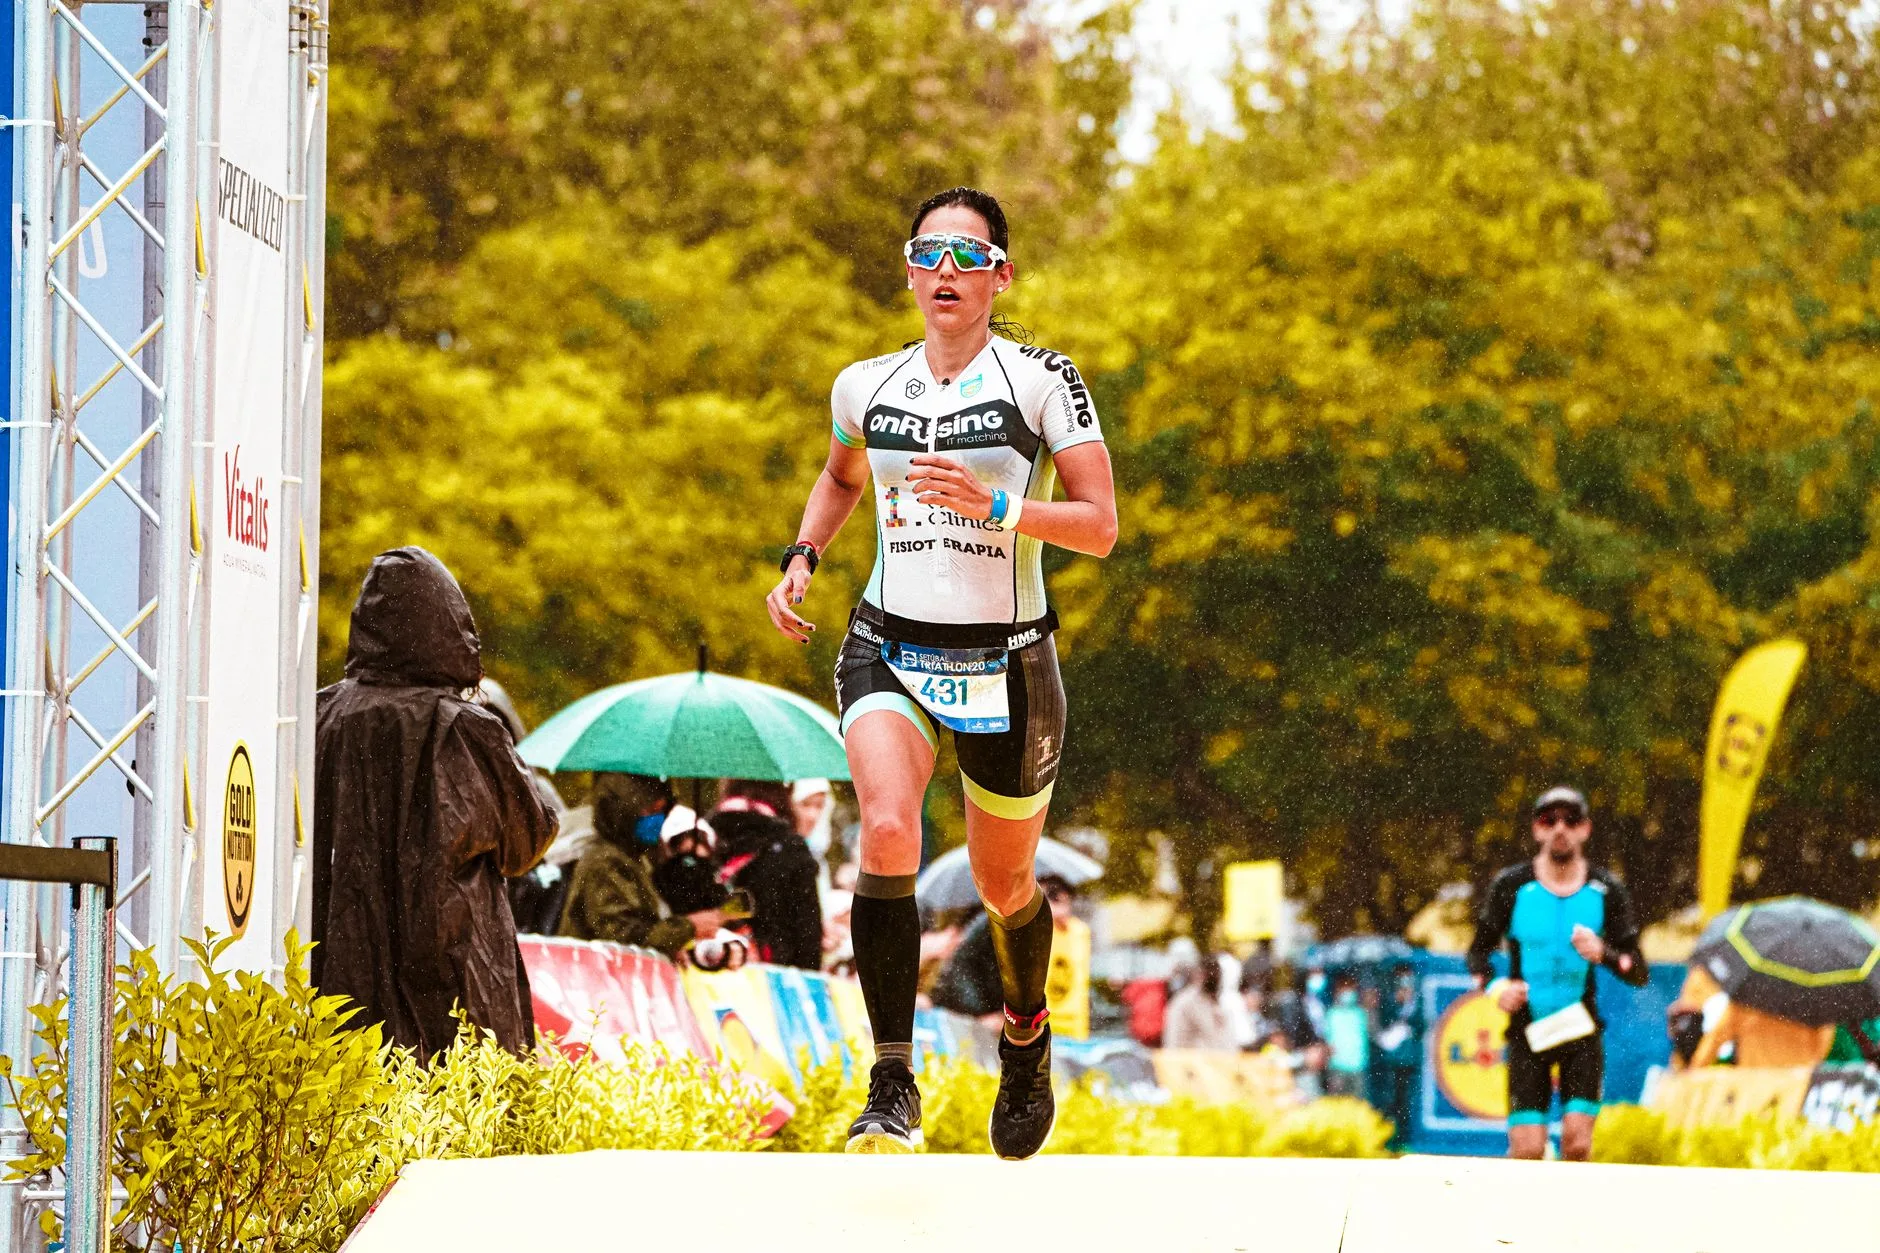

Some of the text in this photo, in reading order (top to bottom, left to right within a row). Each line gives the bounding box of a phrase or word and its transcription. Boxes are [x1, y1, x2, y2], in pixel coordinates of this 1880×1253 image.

[1060, 392, 1076, 433] matching
[946, 431, 1007, 446] IT matching
[225, 444, 268, 552] Vitalis
[920, 677, 968, 706] 431
[229, 783, 251, 829] GOLD
[227, 829, 252, 862] NUTRITION
